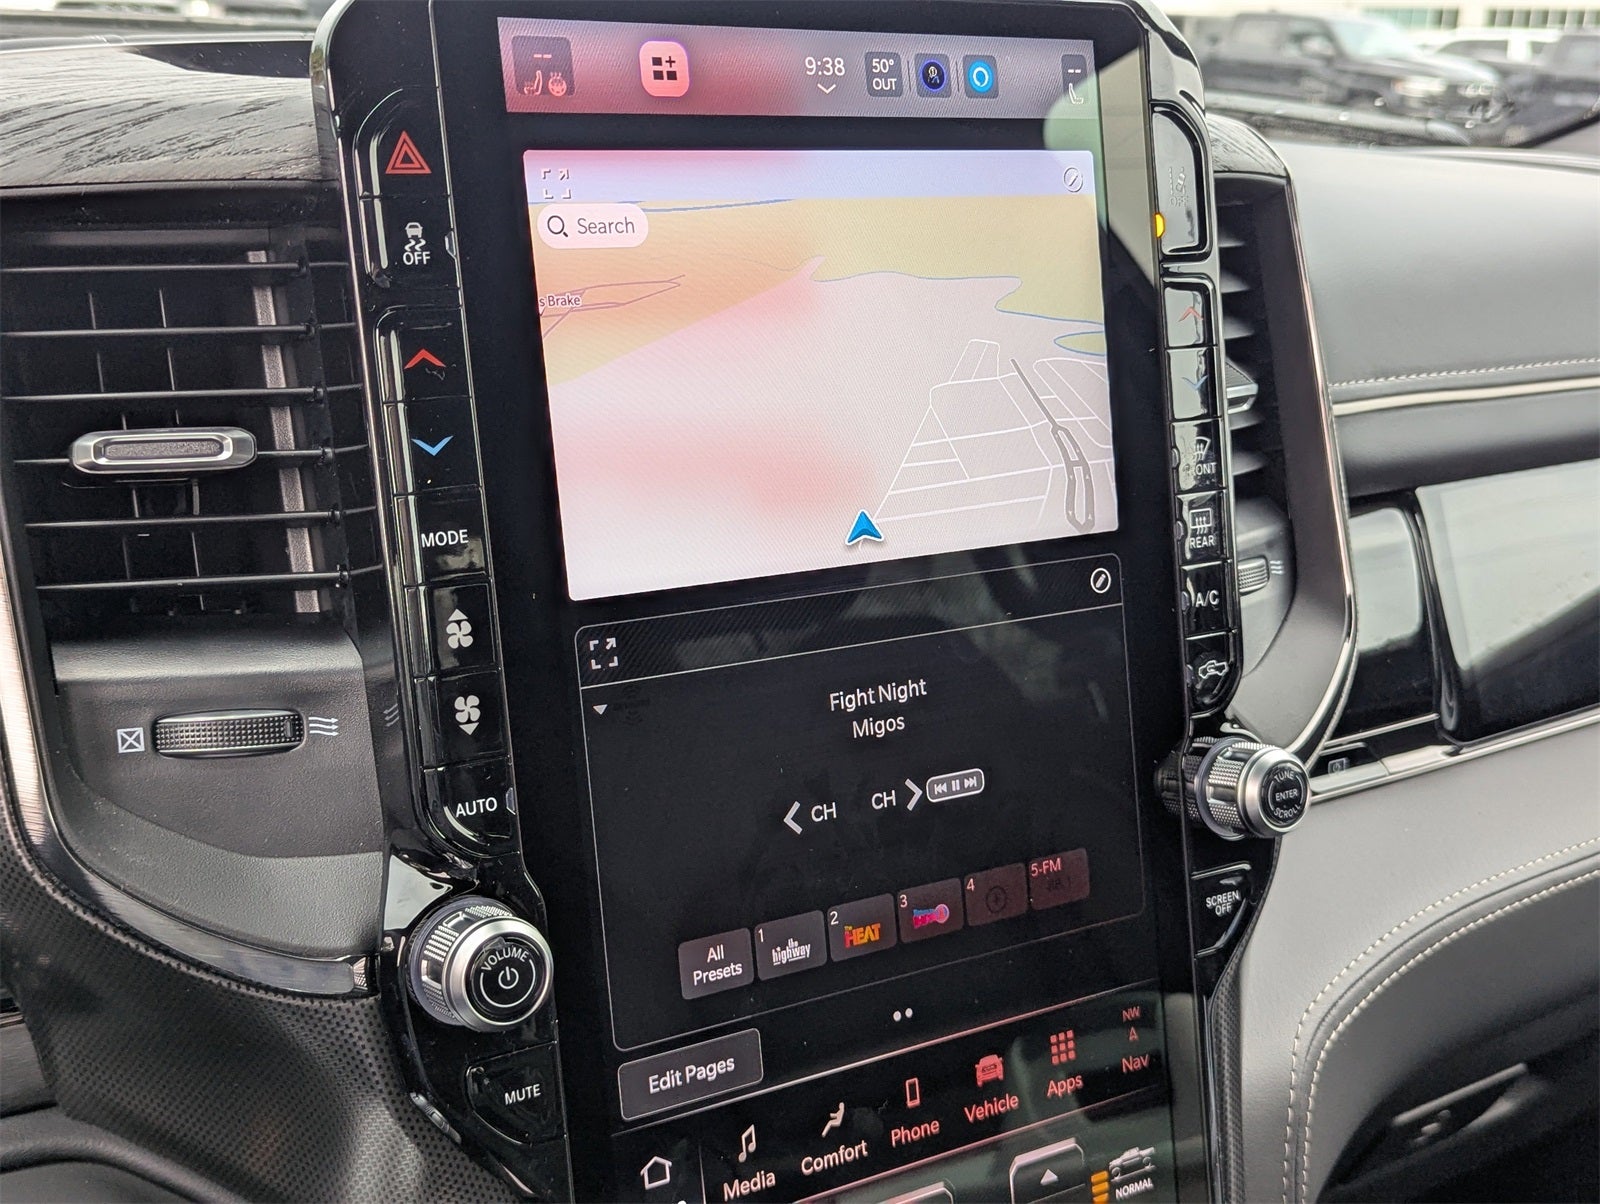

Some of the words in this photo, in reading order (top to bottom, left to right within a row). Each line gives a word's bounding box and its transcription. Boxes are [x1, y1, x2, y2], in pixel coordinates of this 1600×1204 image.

[805, 56, 846, 76] 9:38
[872, 58, 895, 73] 50°
[872, 77, 898, 91] OUT
[577, 216, 635, 236] Search
[402, 251, 431, 266] OFF
[548, 293, 581, 308] Brake
[421, 528, 469, 548] MODE
[1189, 534, 1215, 548] REAR
[1195, 589, 1220, 607] A/C
[829, 688, 876, 712] Fight
[878, 678, 928, 703] Night
[852, 715, 906, 738] Migos
[1273, 769, 1295, 783] TUNE
[871, 790, 896, 809] CH
[1275, 788, 1298, 801] ENTER
[455, 796, 498, 818] AUTO
[811, 802, 837, 822] CH
[1273, 803, 1301, 819] SCROLL
[1031, 857, 1062, 877] 5-FM
[966, 878, 975, 892] 4
[900, 894, 908, 908] 3
[1205, 889, 1240, 909] SCREEN
[1215, 901, 1232, 917] OFF
[829, 911, 839, 926] 2
[758, 928, 765, 943] 1
[844, 923, 881, 949] HEAT
[481, 947, 530, 972] VOLUME
[706, 943, 725, 963] All
[772, 944, 811, 965] highway
[693, 962, 743, 986] Presets
[1122, 1006, 1141, 1022] NW
[1121, 1053, 1150, 1074] Nav
[648, 1067, 683, 1094] Edit
[685, 1057, 735, 1084] Pages
[504, 1083, 541, 1105] MUTE
[1047, 1074, 1084, 1098] Apps
[964, 1093, 1020, 1124] Vehicle
[891, 1118, 940, 1148] Phone
[801, 1139, 868, 1176] Comfort
[723, 1170, 776, 1202] Media
[1115, 1177, 1154, 1200] NORMAL
